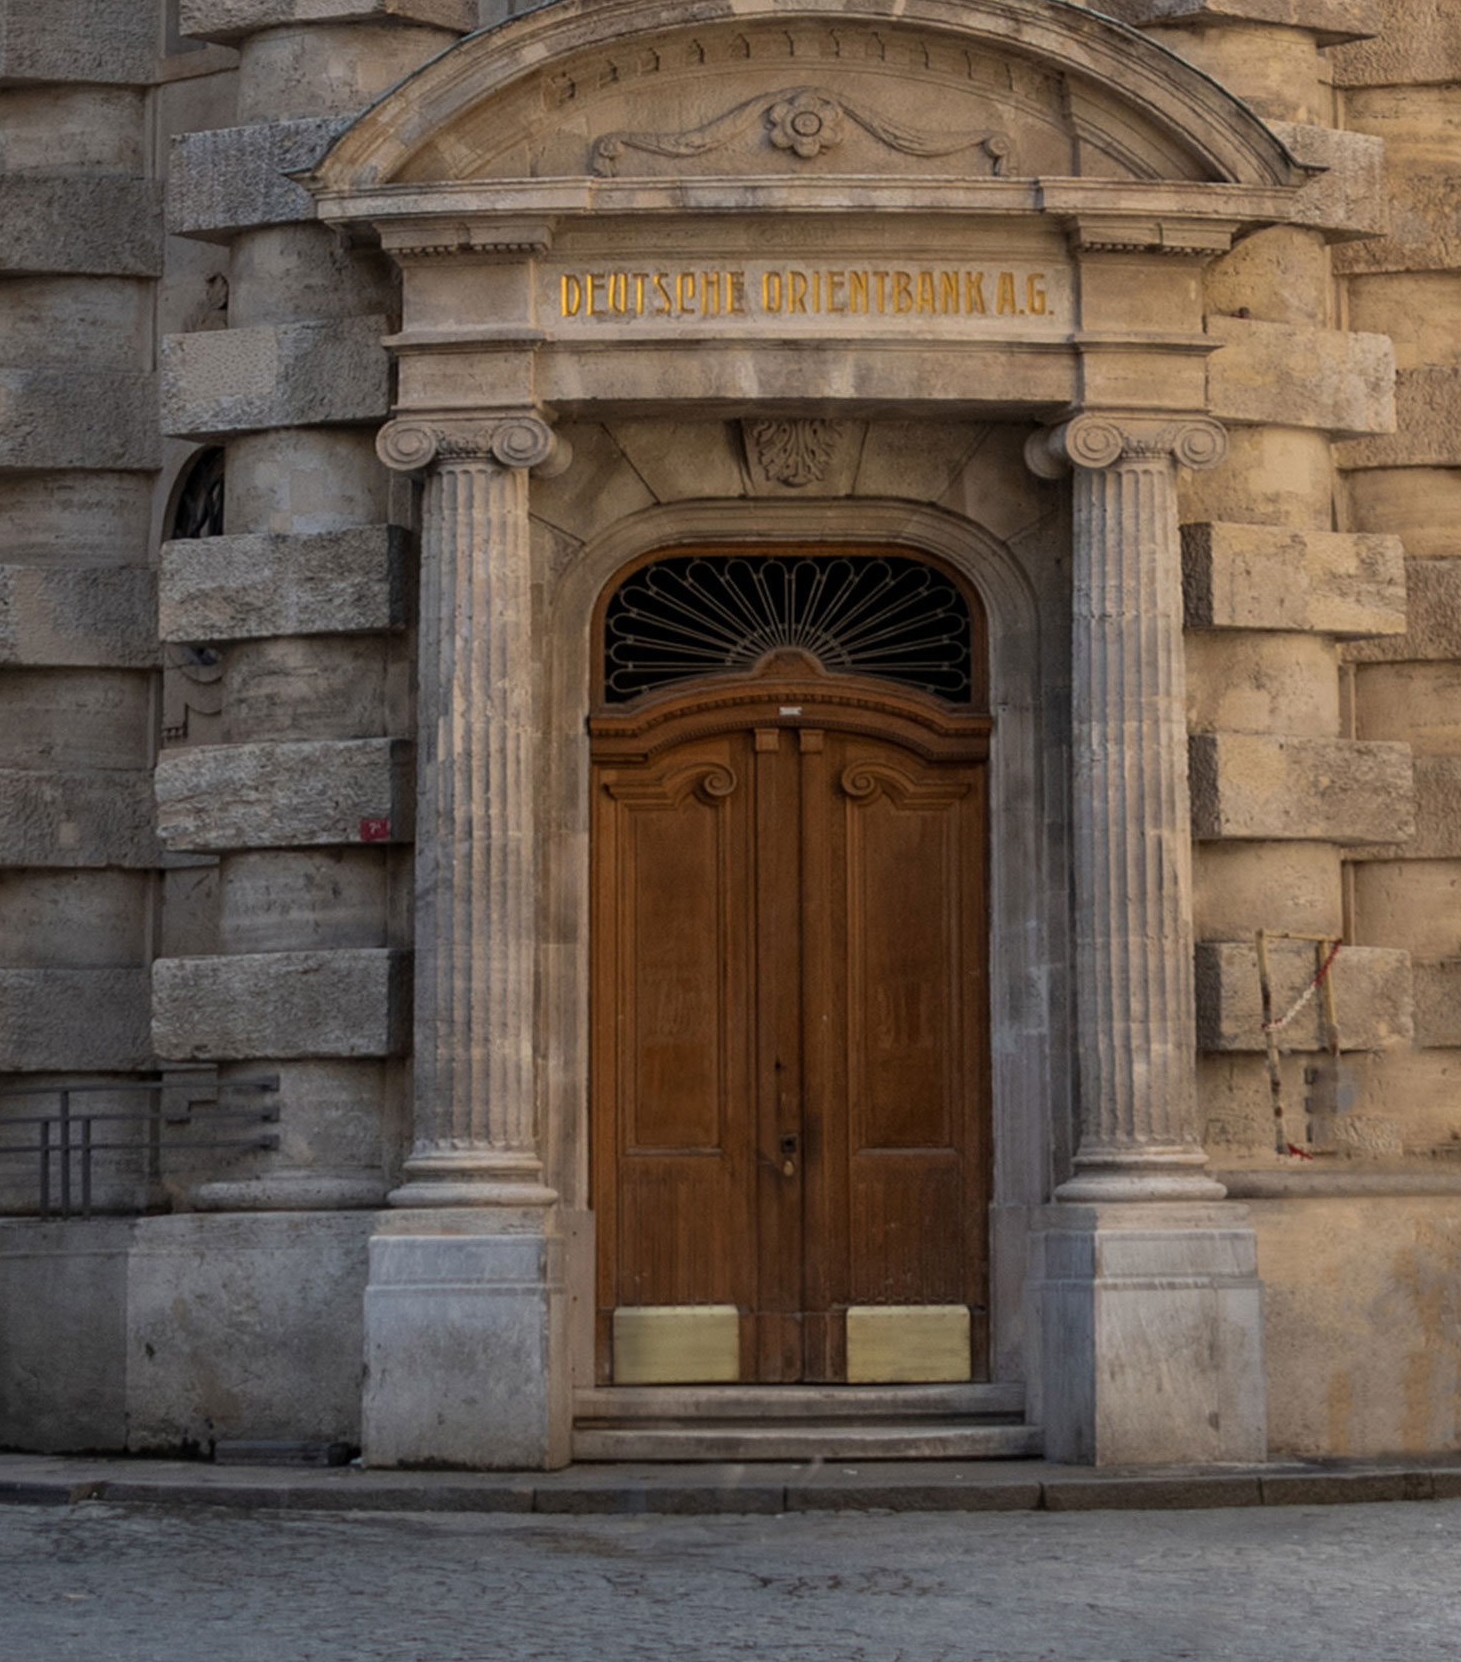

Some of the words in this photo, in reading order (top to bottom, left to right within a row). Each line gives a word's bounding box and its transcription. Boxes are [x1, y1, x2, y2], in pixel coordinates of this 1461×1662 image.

[561, 271, 745, 316] DEUTSCHE
[762, 270, 985, 314] ORIENTBANK
[996, 270, 1055, 316] A.G.
